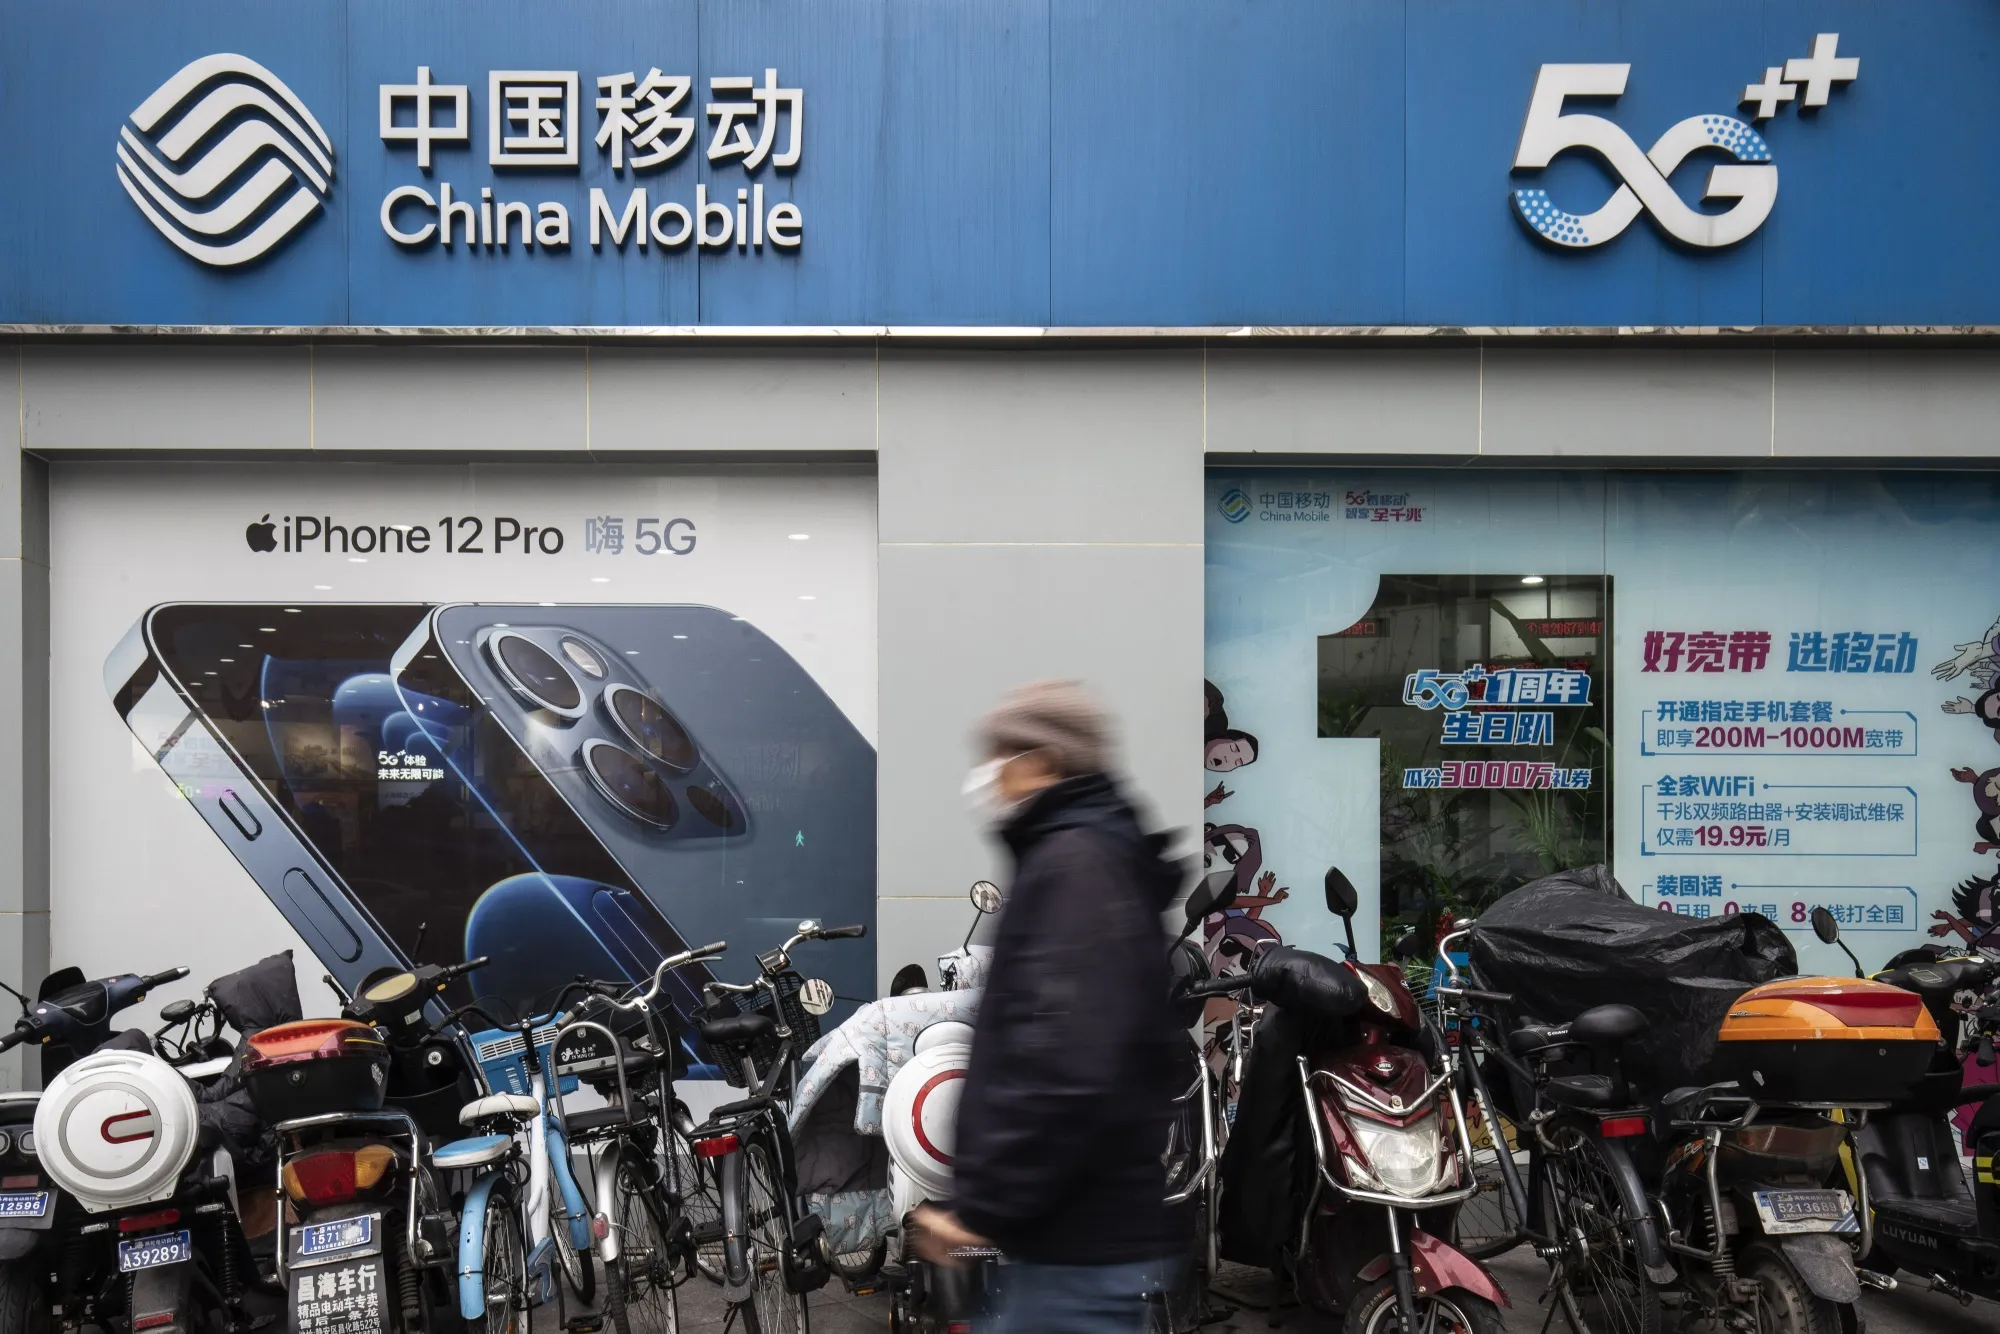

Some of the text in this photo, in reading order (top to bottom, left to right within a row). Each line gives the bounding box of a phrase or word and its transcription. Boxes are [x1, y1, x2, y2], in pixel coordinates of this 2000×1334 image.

[380, 66, 804, 172] 中国移动
[380, 183, 803, 248] China Mobile
[1259, 491, 1330, 509] 中国移动
[1259, 511, 1330, 522] China Mobile
[283, 515, 698, 555] iPhone 12 Pro 嗨 5G
[1641, 630, 1919, 674] 好宽带 选移动
[1656, 701, 1833, 723] 开通指定手机套餐
[1440, 711, 1554, 745] 生日趴
[1656, 726, 1904, 749] 即享200M-1000M宽带
[377, 768, 445, 781] 未来无限可能
[1402, 760, 1593, 790] 瓜分3000万礼券
[1656, 774, 1755, 797] 全家WiFi
[1656, 802, 1905, 822] 千兆双频路由器+安装调试维保
[1656, 825, 1791, 847] 仅需19.9元/月
[1656, 875, 1723, 897] 装固话
[1882, 1224, 1938, 1249] LUYUAN
[297, 1264, 377, 1303] 昌海车行
[297, 1292, 379, 1318] 精品电动车专卖
[298, 1308, 379, 1330] 售后一条龙
